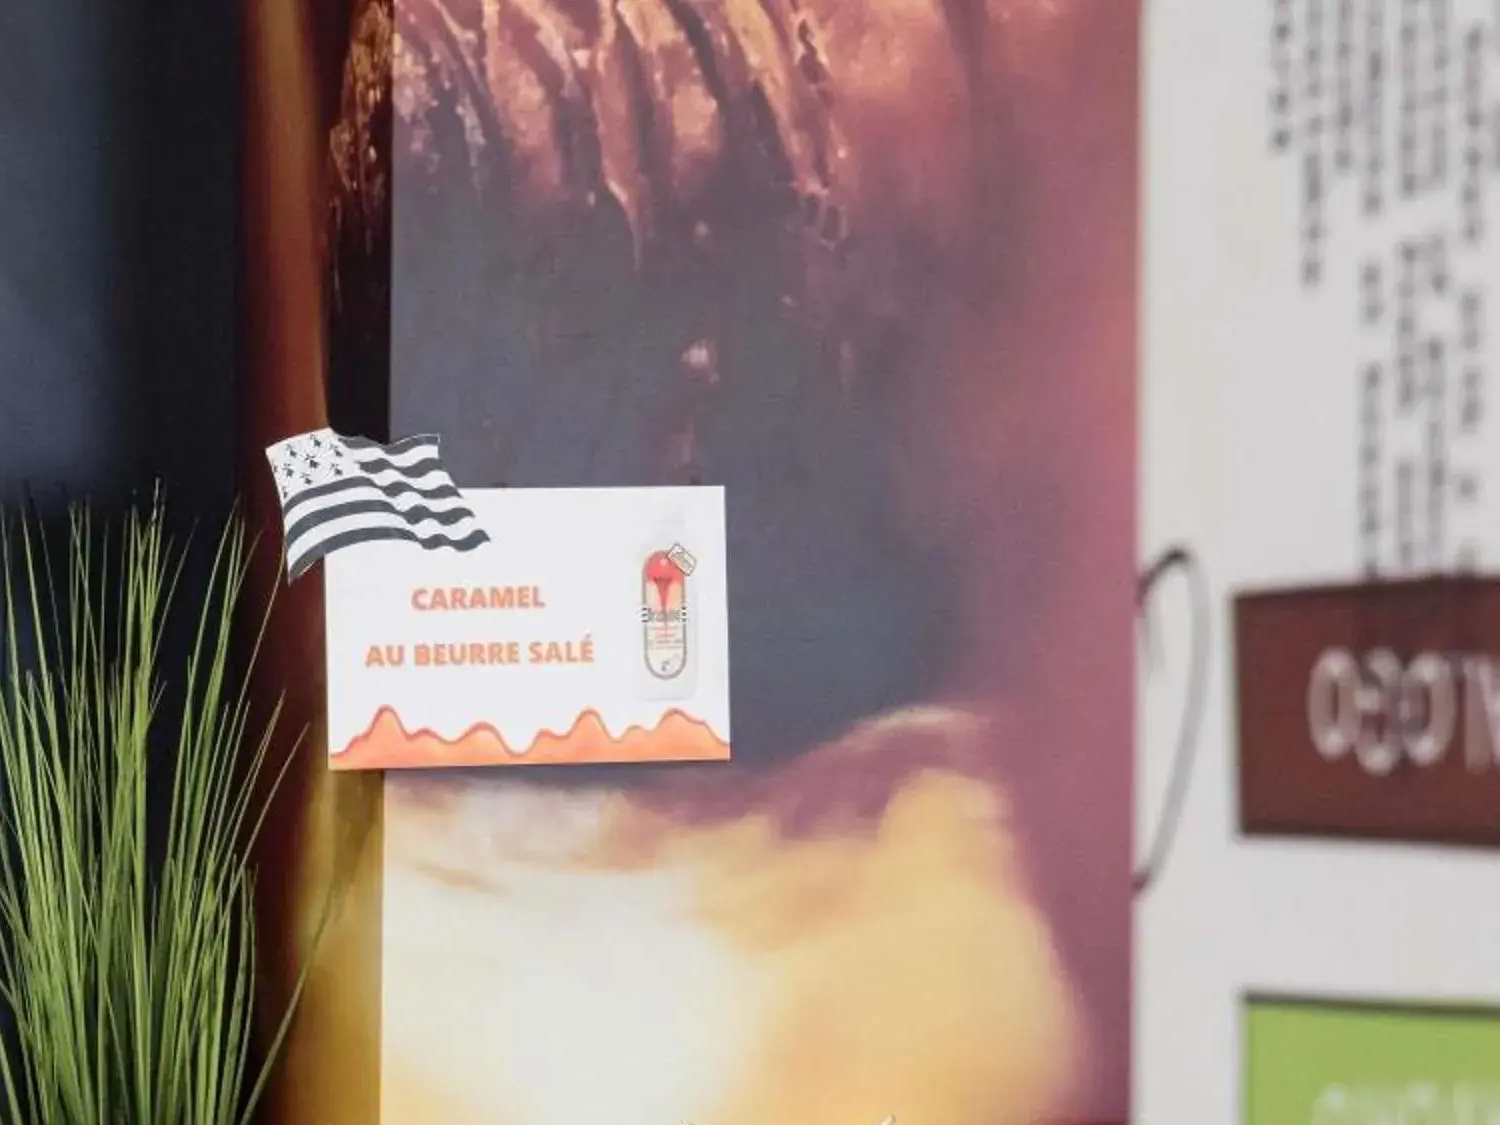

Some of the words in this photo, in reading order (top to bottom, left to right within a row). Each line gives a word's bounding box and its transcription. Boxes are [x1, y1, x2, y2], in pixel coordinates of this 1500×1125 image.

[410, 585, 546, 612] CARAMEL
[364, 644, 405, 669] AU
[413, 641, 521, 667] BEURRE
[527, 633, 596, 665] SALÉ
